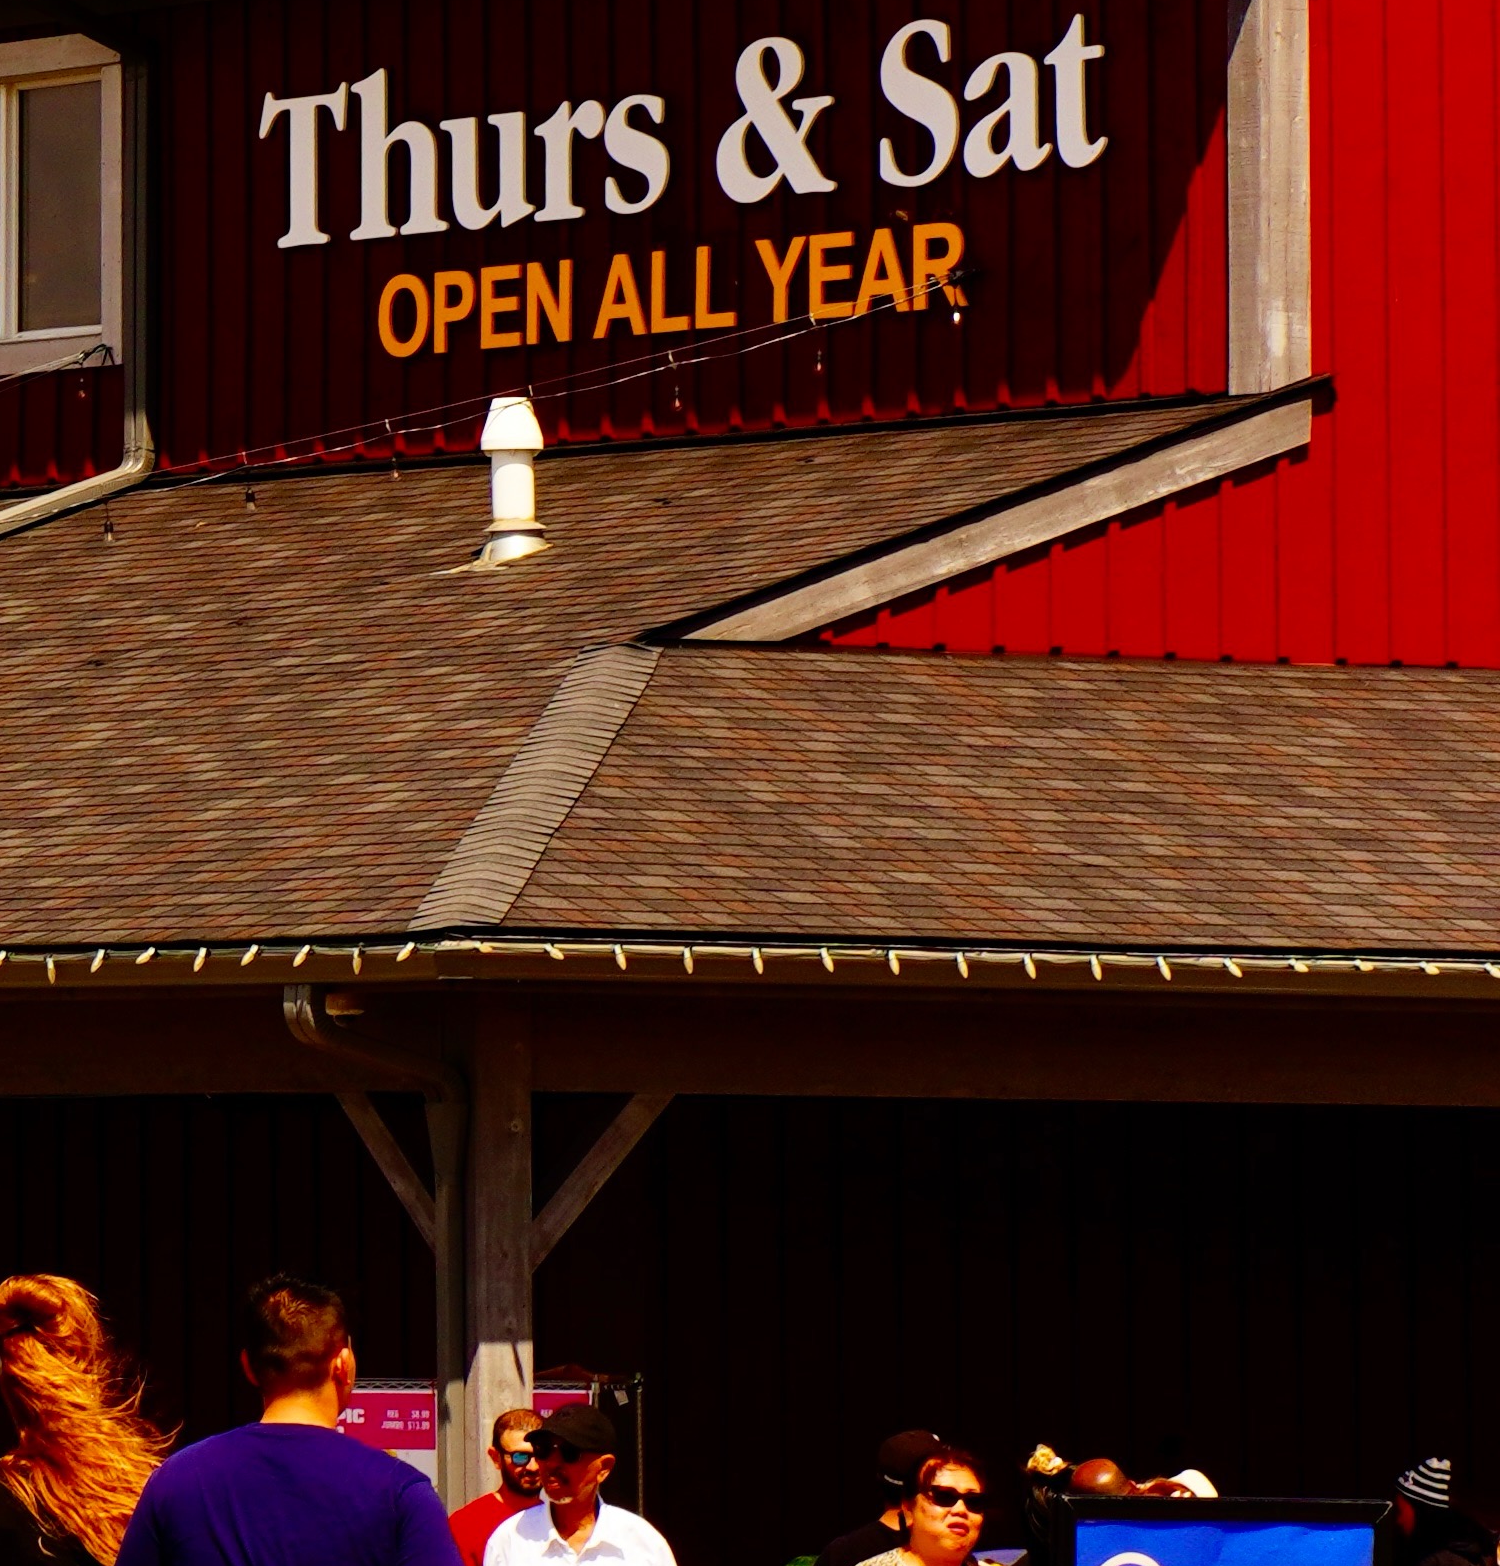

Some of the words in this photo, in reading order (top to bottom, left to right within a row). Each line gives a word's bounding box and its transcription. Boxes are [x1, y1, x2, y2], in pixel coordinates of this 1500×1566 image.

[258, 67, 671, 249] Thurs
[716, 36, 838, 204] &
[878, 13, 1109, 189] Sat
[377, 258, 574, 358] OPEN
[593, 245, 738, 340] ALL
[755, 221, 970, 324] YEAR
